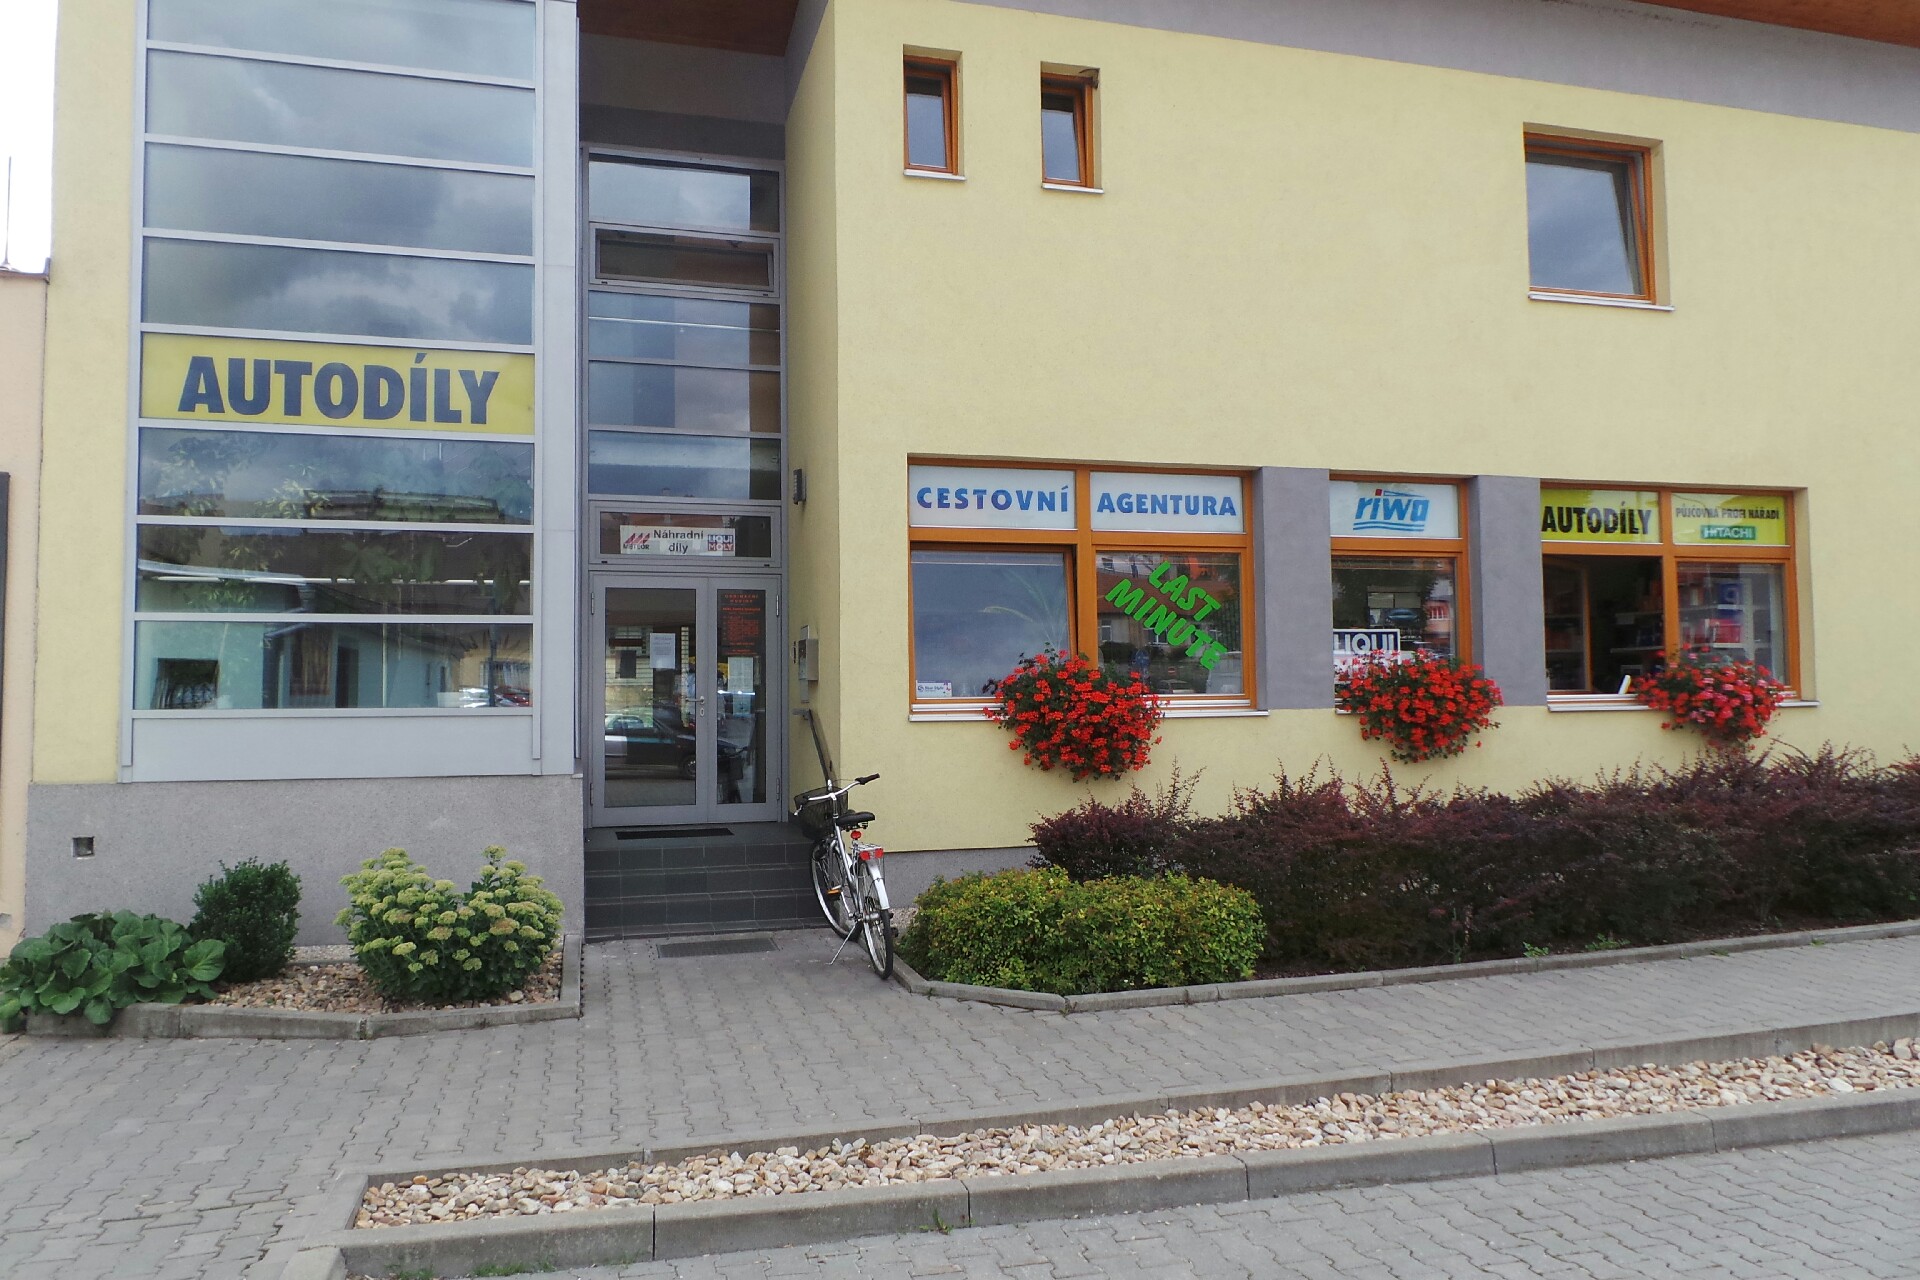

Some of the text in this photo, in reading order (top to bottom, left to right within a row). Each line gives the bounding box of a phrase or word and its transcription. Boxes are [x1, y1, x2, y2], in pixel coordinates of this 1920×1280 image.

[178, 353, 500, 425] AUTODÍLY
[916, 485, 1070, 513] CESTOVNÍ
[1097, 492, 1238, 516] AGENTURA
[1541, 501, 1652, 535] AUTODÍLY
[653, 529, 704, 540] Náhradní
[708, 535, 734, 543] LIQUI
[1704, 527, 1752, 539] HITACHI
[668, 542, 689, 554] díly
[708, 543, 734, 551] MOLY
[1149, 560, 1222, 622] LAST
[1105, 578, 1228, 671] MINUTE
[1333, 633, 1395, 656] LIQUI
